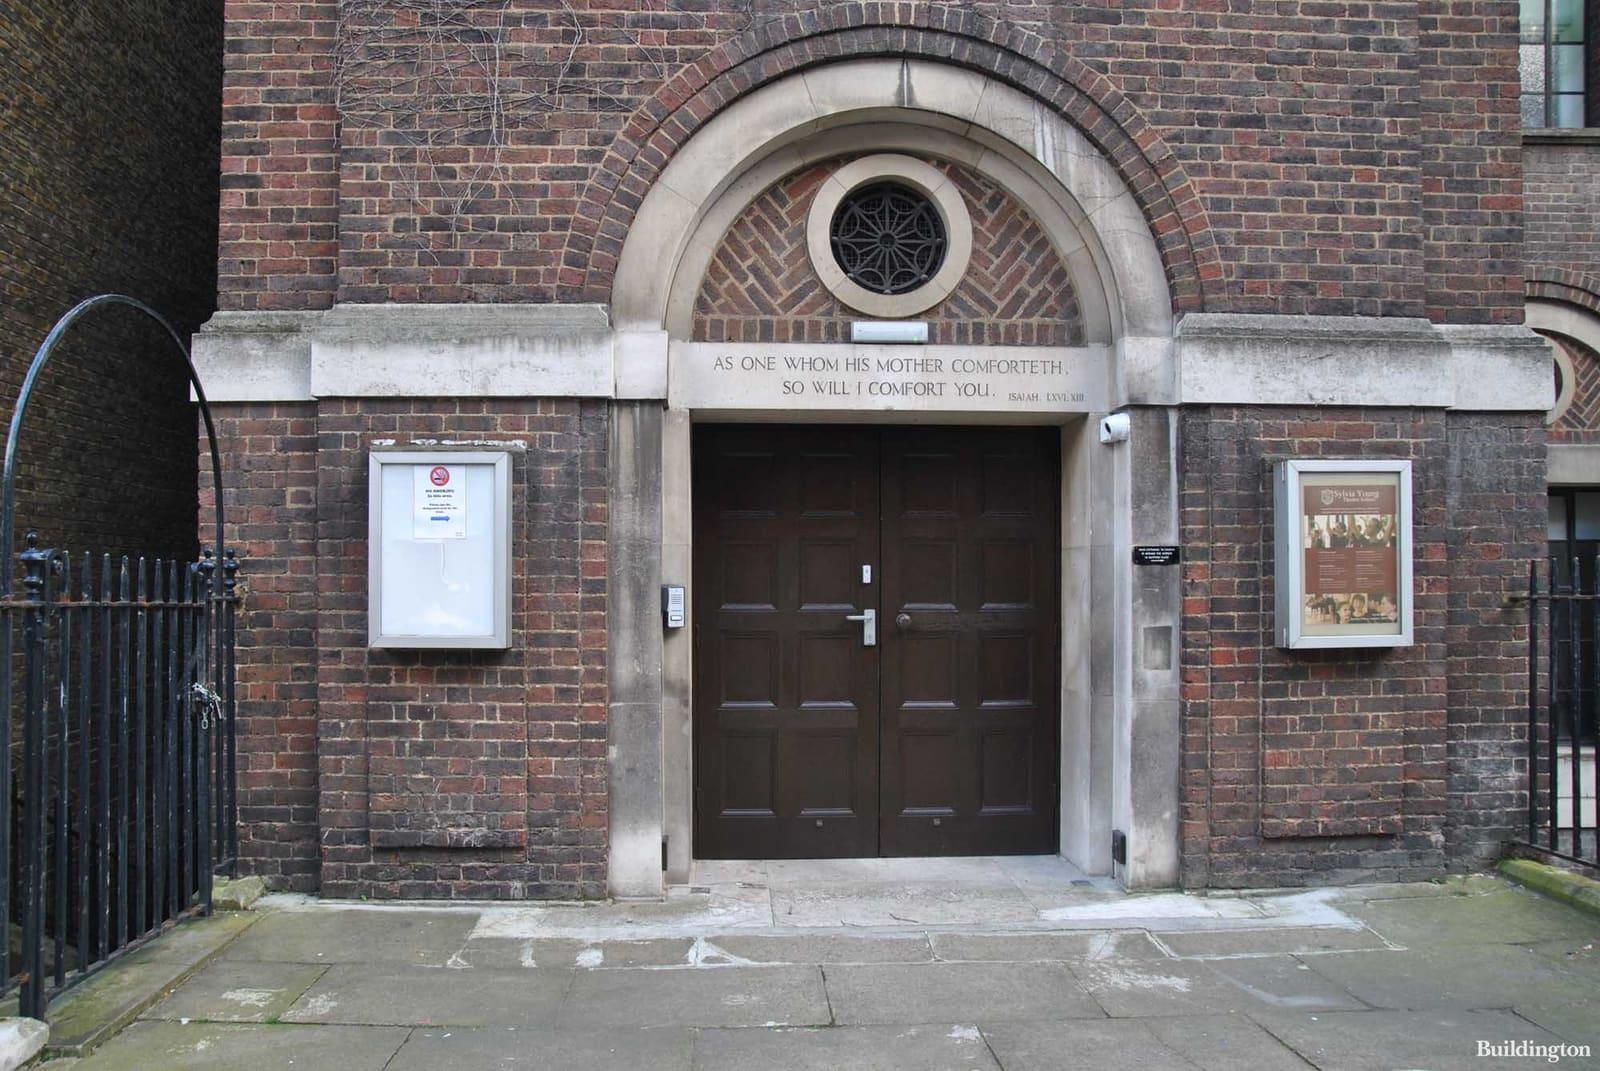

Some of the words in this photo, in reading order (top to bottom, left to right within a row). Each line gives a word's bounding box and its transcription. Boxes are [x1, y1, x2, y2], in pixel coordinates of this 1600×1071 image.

[714, 356, 734, 370] AS
[741, 356, 776, 371] ONE
[784, 357, 839, 372] WHOM
[846, 357, 870, 372] HIS
[877, 358, 944, 374] MOTHER
[783, 381, 804, 395] SO
[812, 381, 849, 395] WILL
[857, 382, 861, 395] I
[868, 382, 946, 397] COMFORT
[954, 382, 996, 397] YOU.
[1356, 489, 1379, 499] Young
